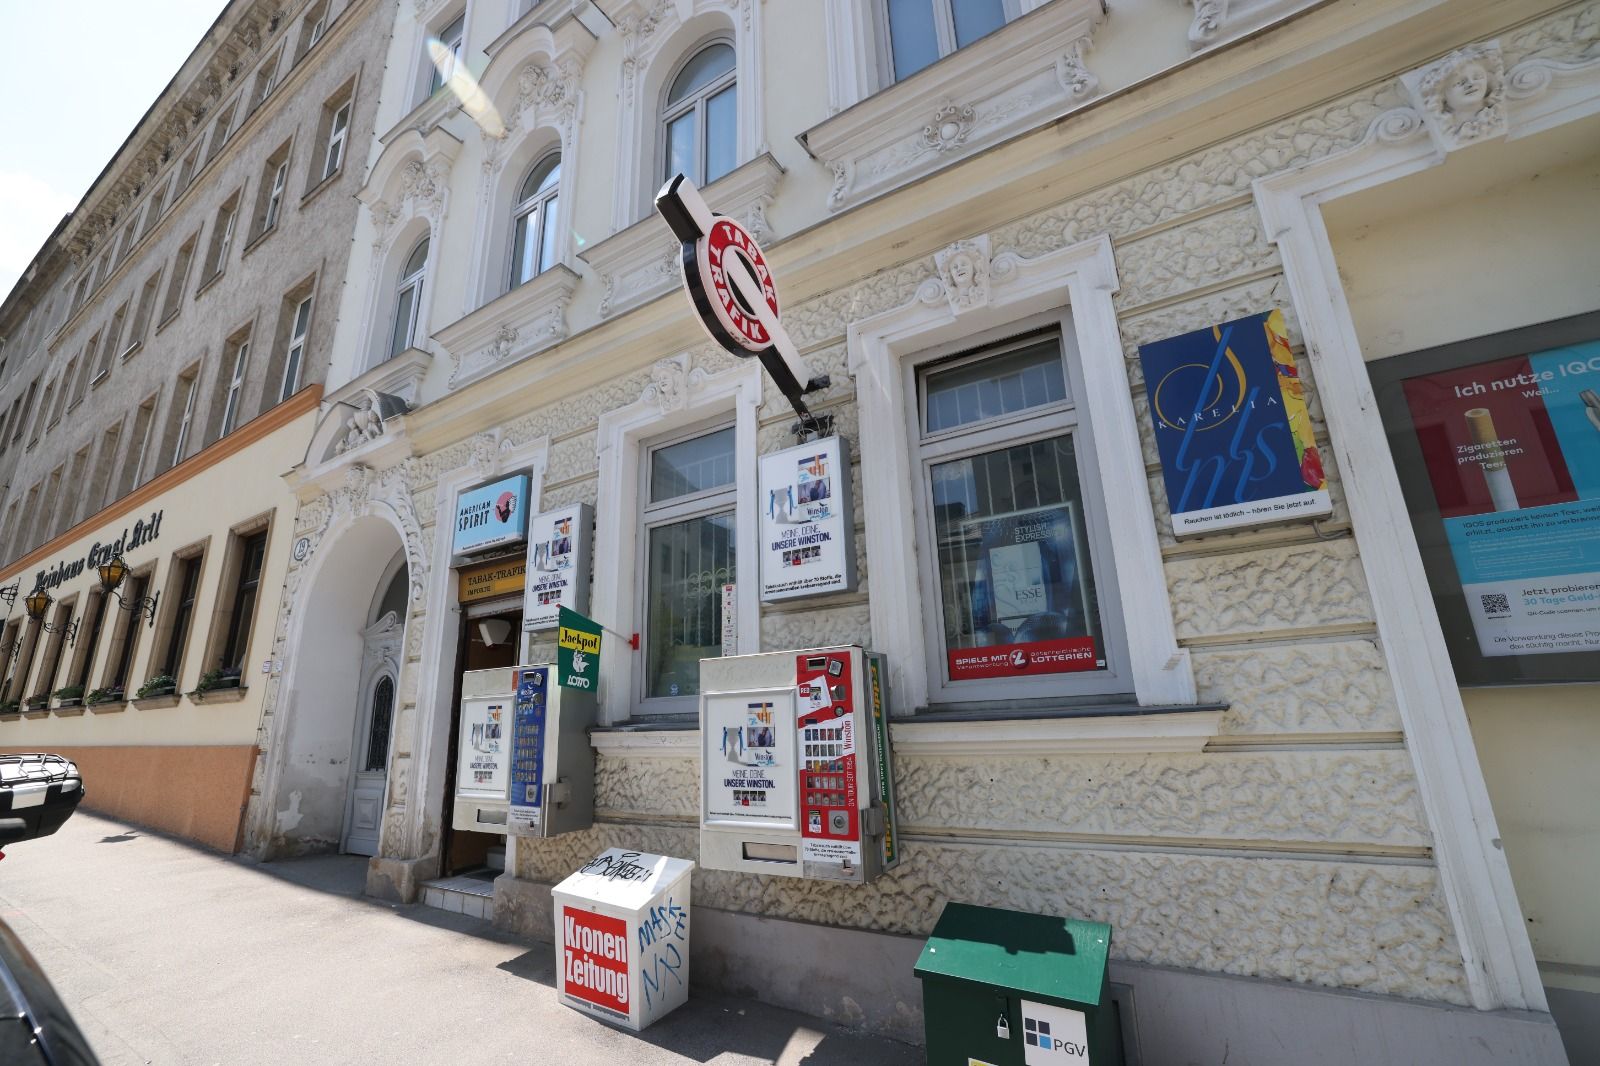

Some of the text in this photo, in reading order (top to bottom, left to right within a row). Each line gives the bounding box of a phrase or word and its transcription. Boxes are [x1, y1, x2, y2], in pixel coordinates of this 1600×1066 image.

[722, 225, 776, 303] TABAK
[710, 244, 762, 341] TRAFIK
[1455, 381, 1486, 398] Ich
[1490, 370, 1554, 391] nutze
[1158, 396, 1277, 429] KARELIA
[1457, 438, 1517, 454] Zigaretten
[1457, 447, 1524, 465] produzieren
[1479, 460, 1507, 470] Teer.
[460, 500, 491, 517] AMERICAN
[1184, 515, 1212, 525] Rauchen
[1223, 510, 1245, 519] tödlich
[1252, 506, 1272, 515] hören
[1286, 501, 1302, 510] jetzt
[1303, 498, 1317, 506] auf.
[458, 510, 490, 531] SPIRIT
[1014, 523, 1048, 535] STYLISH
[771, 532, 832, 551] UNSERE WINSTON.
[31, 557, 85, 594] Weinhaus
[87, 528, 128, 569] Ernst
[1015, 587, 1043, 600] ESSE
[1521, 587, 1549, 597] Jetzt
[1540, 595, 1566, 605] Tage
[561, 630, 598, 650] Jackpot
[955, 654, 1008, 665] SPIELE MIT
[1031, 652, 1092, 663] LOTTERIEN
[567, 675, 590, 688] LOTTO
[843, 720, 852, 750] Winston
[723, 778, 776, 789] UNSERE WINSTON.
[564, 915, 627, 963] Kronen
[564, 949, 628, 1004] Zeitung
[1053, 1038, 1086, 1057] PGV
